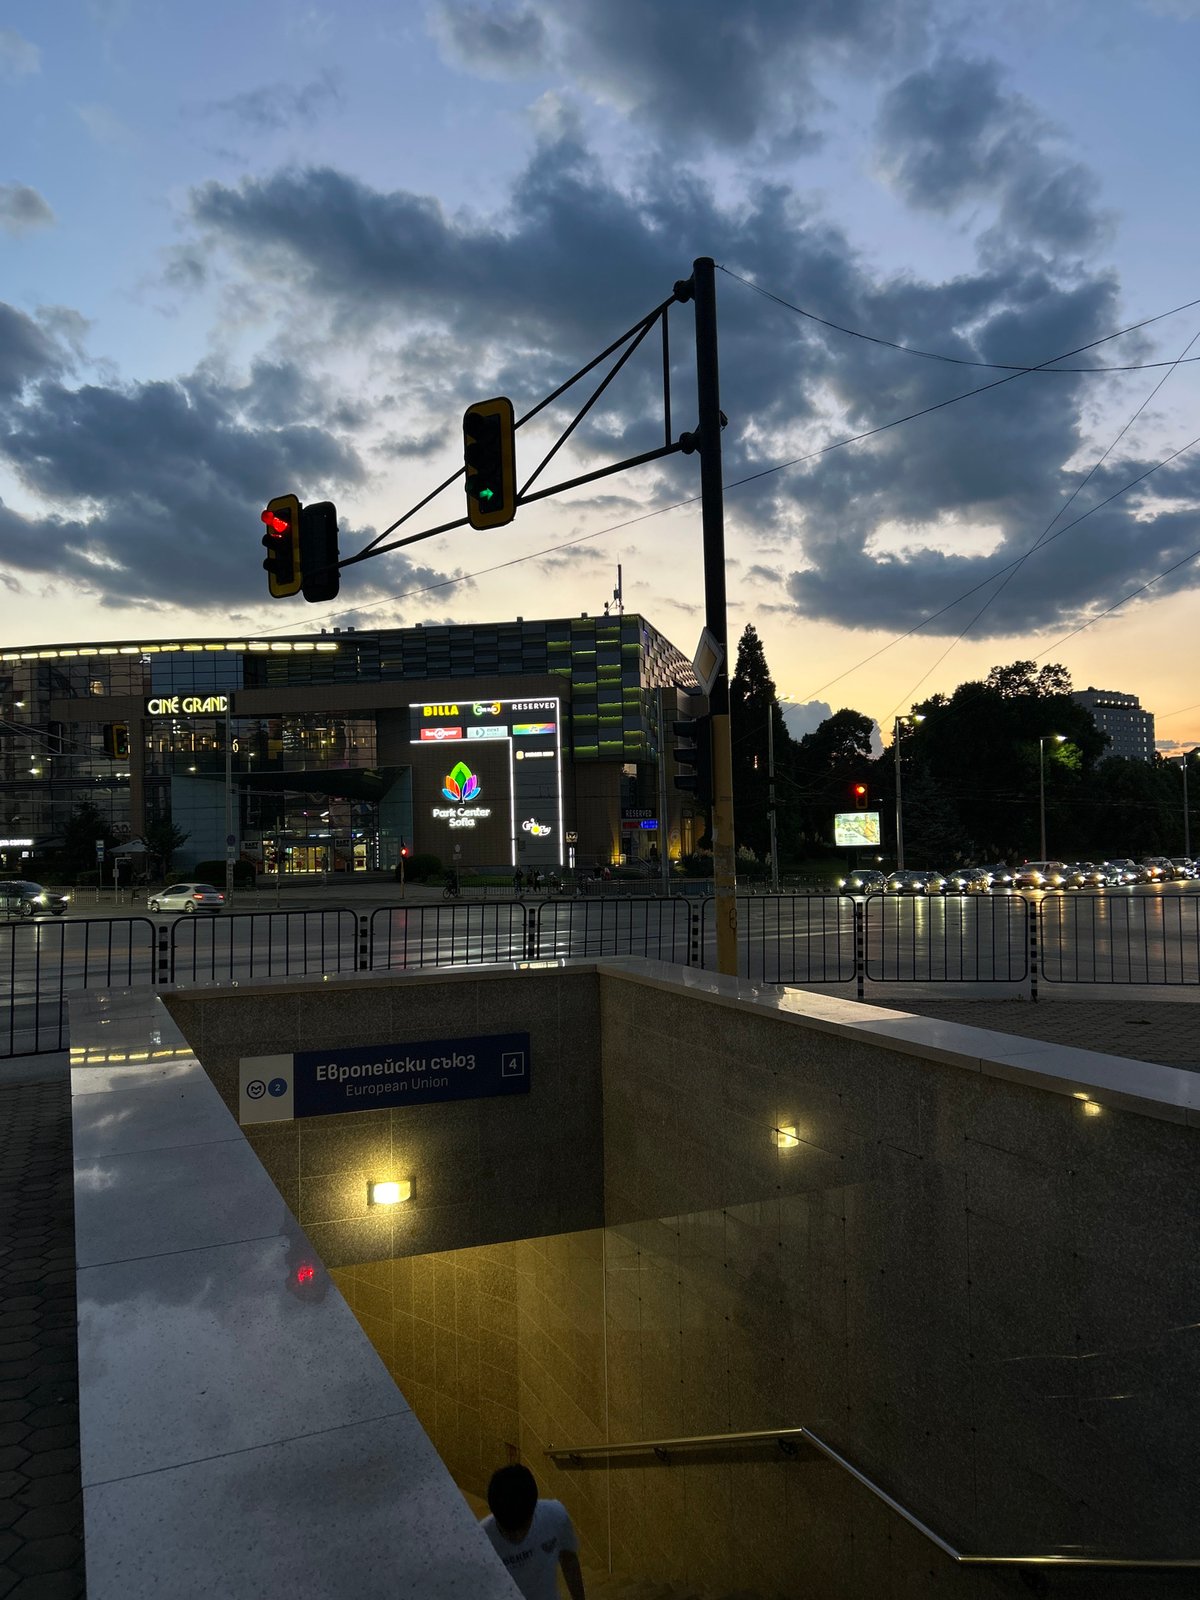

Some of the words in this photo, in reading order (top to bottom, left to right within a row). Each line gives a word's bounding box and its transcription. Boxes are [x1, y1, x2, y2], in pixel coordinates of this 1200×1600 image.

[147, 696, 180, 715] CINÉ
[182, 696, 228, 713] GRAND
[423, 704, 459, 717] BILLA
[512, 702, 556, 711] RESERVED
[432, 808, 456, 818] Park
[457, 807, 491, 817] Center
[625, 809, 652, 817] RESERVED
[449, 817, 476, 827] Sofia
[316, 1056, 426, 1083] Европейски
[431, 1052, 476, 1071] съюз
[508, 1058, 517, 1070] 4
[346, 1081, 408, 1097] European
[411, 1075, 449, 1091] Union
